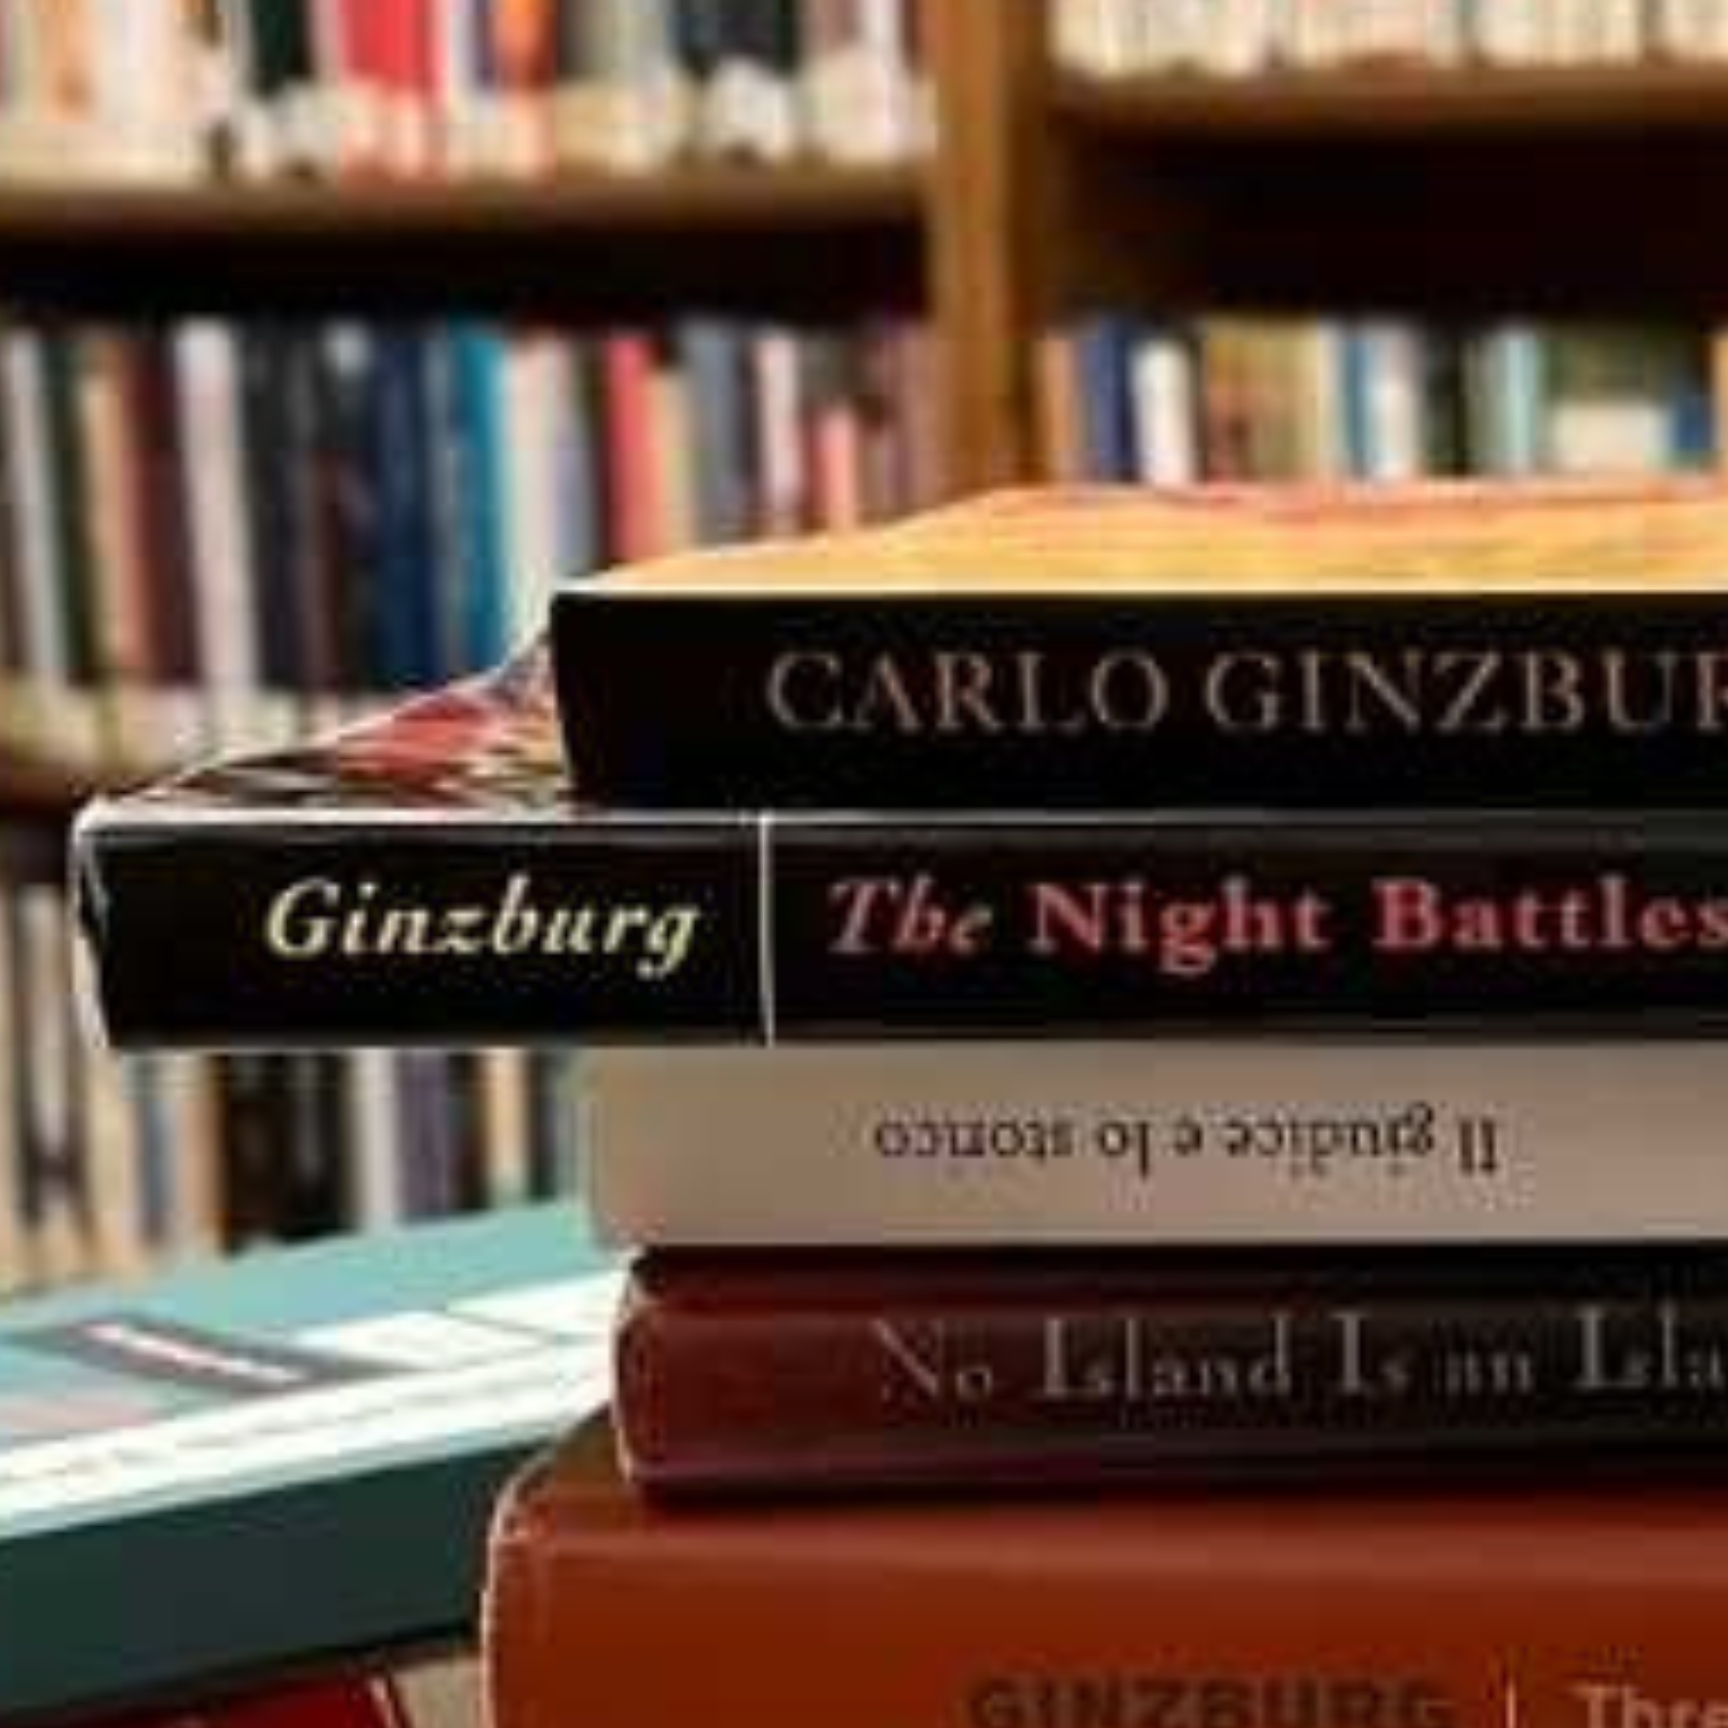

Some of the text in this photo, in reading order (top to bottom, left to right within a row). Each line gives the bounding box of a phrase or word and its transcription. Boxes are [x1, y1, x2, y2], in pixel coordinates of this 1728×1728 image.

[764, 646, 1169, 736] CARLO
[266, 870, 702, 980] Ginzburg
[826, 873, 994, 960] The
[1024, 876, 1332, 978] Night
[874, 1101, 1500, 1180] Il giudice e lo storico
[872, 1316, 994, 1400] No
[1040, 1311, 1292, 1400] Island
[1332, 1309, 1415, 1398] Is
[1442, 1346, 1534, 1392] an
